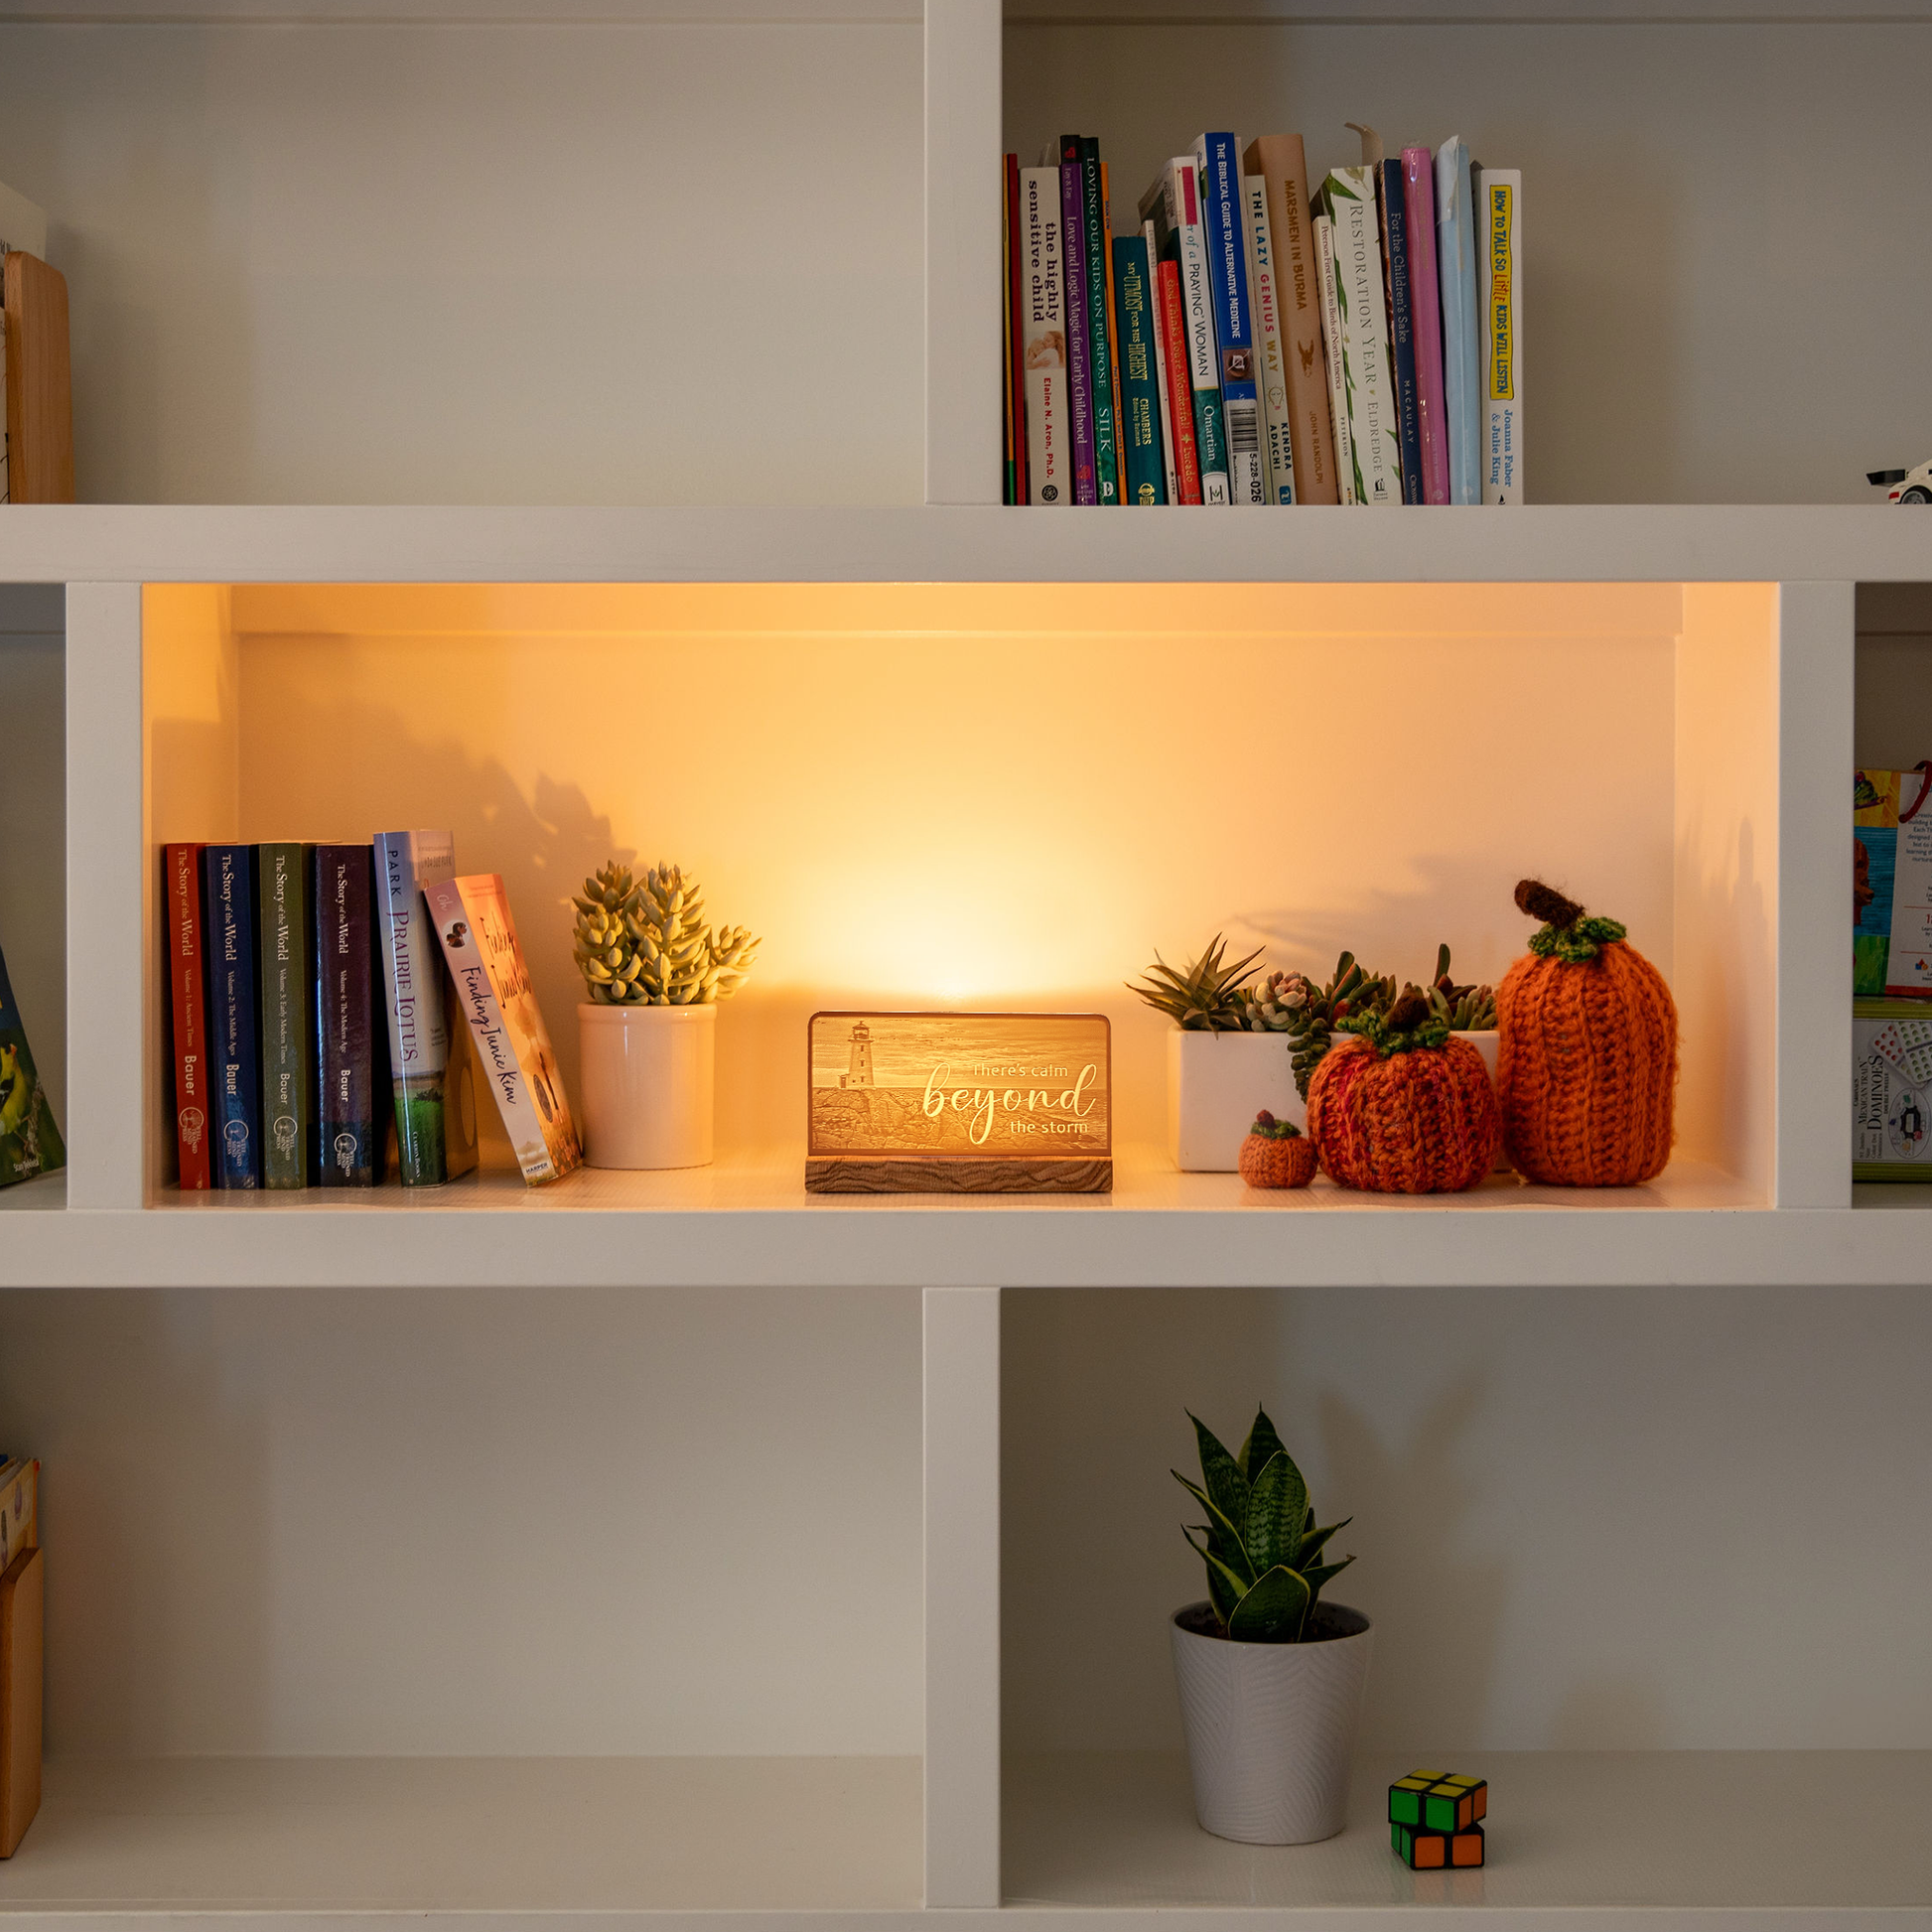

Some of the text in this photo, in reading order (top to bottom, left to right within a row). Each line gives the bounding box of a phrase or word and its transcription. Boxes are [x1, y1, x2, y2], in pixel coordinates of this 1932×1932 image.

[1494, 191, 1506, 213] HOW
[1495, 216, 1506, 227] TO
[1029, 181, 1043, 322] sensitive child
[1216, 143, 1241, 339] THE BIBLICAL GUIDE TO ALTERNATIVE MEDICINE
[1284, 181, 1307, 310] MARSMEN IN BURMA
[1321, 225, 1330, 256] Peterson
[1494, 230, 1507, 255] TALK
[1044, 222, 1059, 322] the highly
[1127, 262, 1136, 276] MY
[1323, 258, 1333, 273] First
[1391, 212, 1409, 343] For the Children's Sake
[1495, 259, 1507, 271] SO
[1123, 275, 1143, 311] UTMOST
[1252, 192, 1278, 371] THE LAZY GENIUS WAY
[1325, 275, 1335, 298] Guide
[1087, 158, 1112, 452] LOVING OUR KIDS ON PURPOSE SILK
[1328, 308, 1337, 326] Birds
[1497, 305, 1507, 330] KIDS
[1066, 216, 1087, 444] Love and Logic Magic for Early Childhood
[1331, 327, 1339, 336] of
[1350, 205, 1383, 472] RESTORATION YEAR ELDREDGE
[1496, 333, 1508, 355] WILL
[1128, 343, 1148, 380] HIGHEST
[1186, 235, 1198, 248] of
[1194, 322, 1209, 376] WOMAN
[1203, 405, 1216, 461] Omartian
[1332, 337, 1342, 358] North
[1333, 360, 1343, 389] America
[1496, 359, 1508, 393] LISTEN
[1169, 304, 1179, 337] Thinks
[1183, 447, 1193, 483] Lucado
[1045, 410, 1052, 420] N.
[1140, 398, 1152, 445] CHAMBERS
[1404, 379, 1414, 443] MACAULAY
[1491, 413, 1500, 422] &
[1270, 425, 1280, 470] ADACHI
[1281, 423, 1292, 470] KENDRA
[1313, 439, 1323, 484] RANDOLPH
[1504, 409, 1513, 486] Joanna Faber
[1250, 454, 1261, 502] 5-228-026
[1490, 457, 1501, 484] King
[178, 850, 188, 867] The
[222, 854, 231, 872] The
[276, 856, 285, 873] The
[337, 864, 345, 880] The
[177, 868, 191, 897] Story
[220, 872, 233, 902] Story
[274, 874, 287, 902] Story
[336, 880, 347, 905] Story
[181, 898, 188, 907] of
[225, 903, 231, 912] of
[278, 904, 285, 913] of
[436, 895, 454, 911] Oh
[182, 919, 194, 956] World
[225, 924, 236, 961] World
[277, 925, 288, 961] World
[339, 923, 348, 954] World
[386, 851, 419, 1062] PARK PRAIRIE LOTUS
[278, 1002, 287, 1018] Early
[339, 1040, 347, 1053] Age
[461, 966, 517, 1105] Finding Junie Kim
[185, 1055, 197, 1095] Bauer
[226, 1064, 239, 1095] Bauer
[341, 1069, 350, 1102] Bauer
[972, 1063, 1068, 1077] There's calm
[280, 1073, 290, 1104] Bauer
[922, 1062, 1097, 1145] beyond
[1858, 1061, 1868, 1124] MEXICAN TRAIN
[1866, 1055, 1883, 1130] DOMINOES
[1011, 1121, 1088, 1134] the storm
[526, 1162, 547, 1173] HARPER
